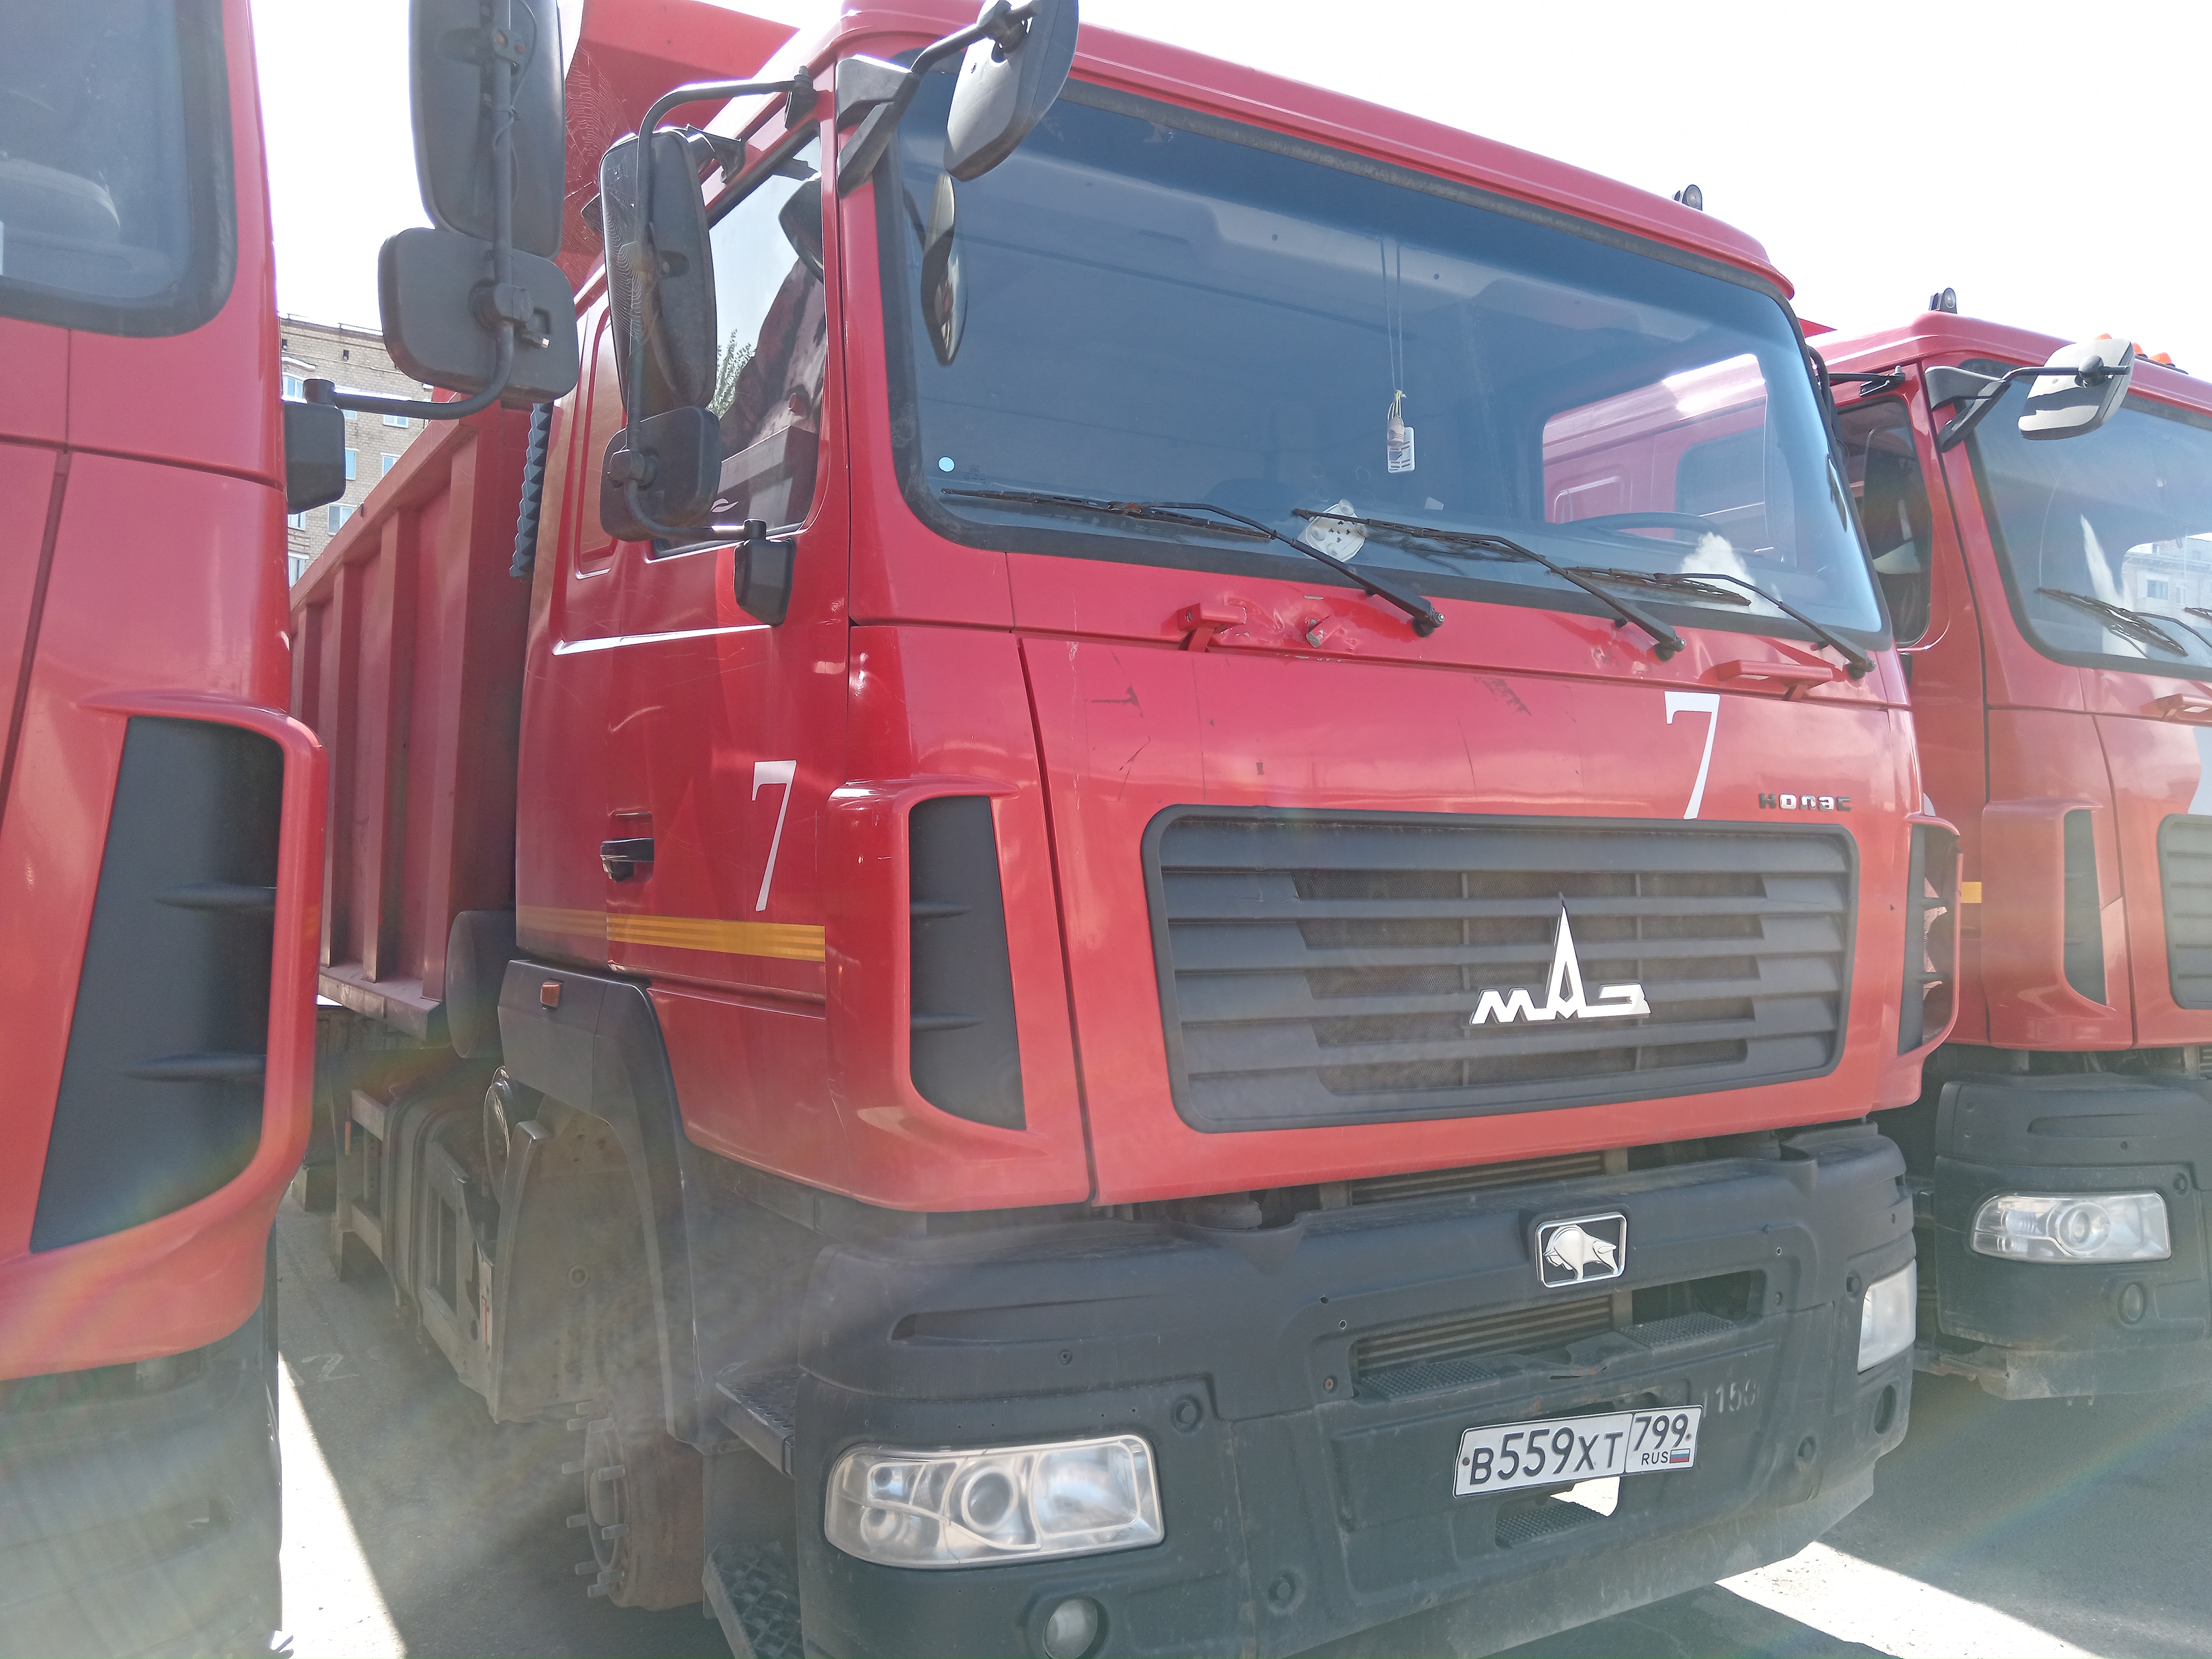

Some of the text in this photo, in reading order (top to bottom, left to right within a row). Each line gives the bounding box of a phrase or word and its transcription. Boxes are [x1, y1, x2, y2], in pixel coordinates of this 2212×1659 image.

[1664, 690, 1720, 820] 7
[751, 760, 797, 912] 7
[1633, 1413, 1689, 1452] 799
[1641, 1451, 1669, 1465] RUS
